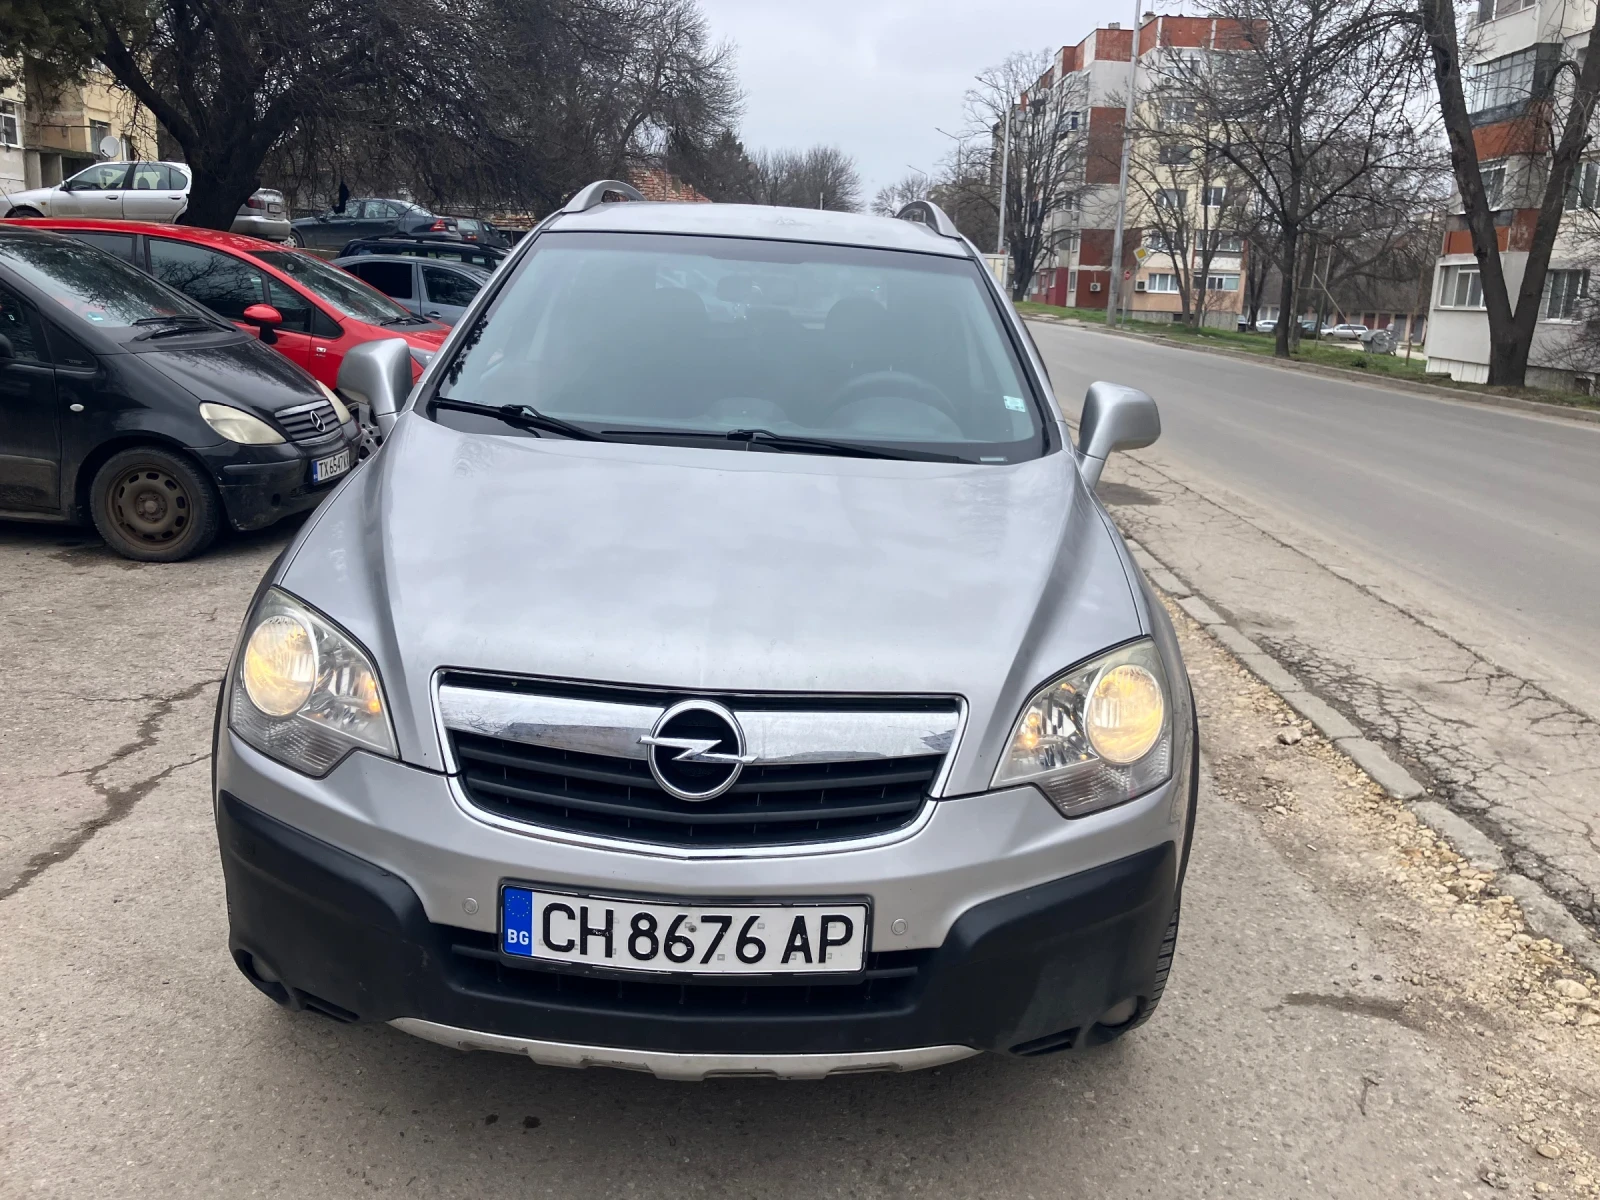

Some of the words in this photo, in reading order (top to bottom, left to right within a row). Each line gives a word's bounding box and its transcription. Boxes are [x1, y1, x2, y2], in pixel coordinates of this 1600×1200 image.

[507, 928, 529, 945] BG
[542, 902, 614, 958] CH
[627, 912, 767, 965] 8676
[780, 914, 854, 964] AP
